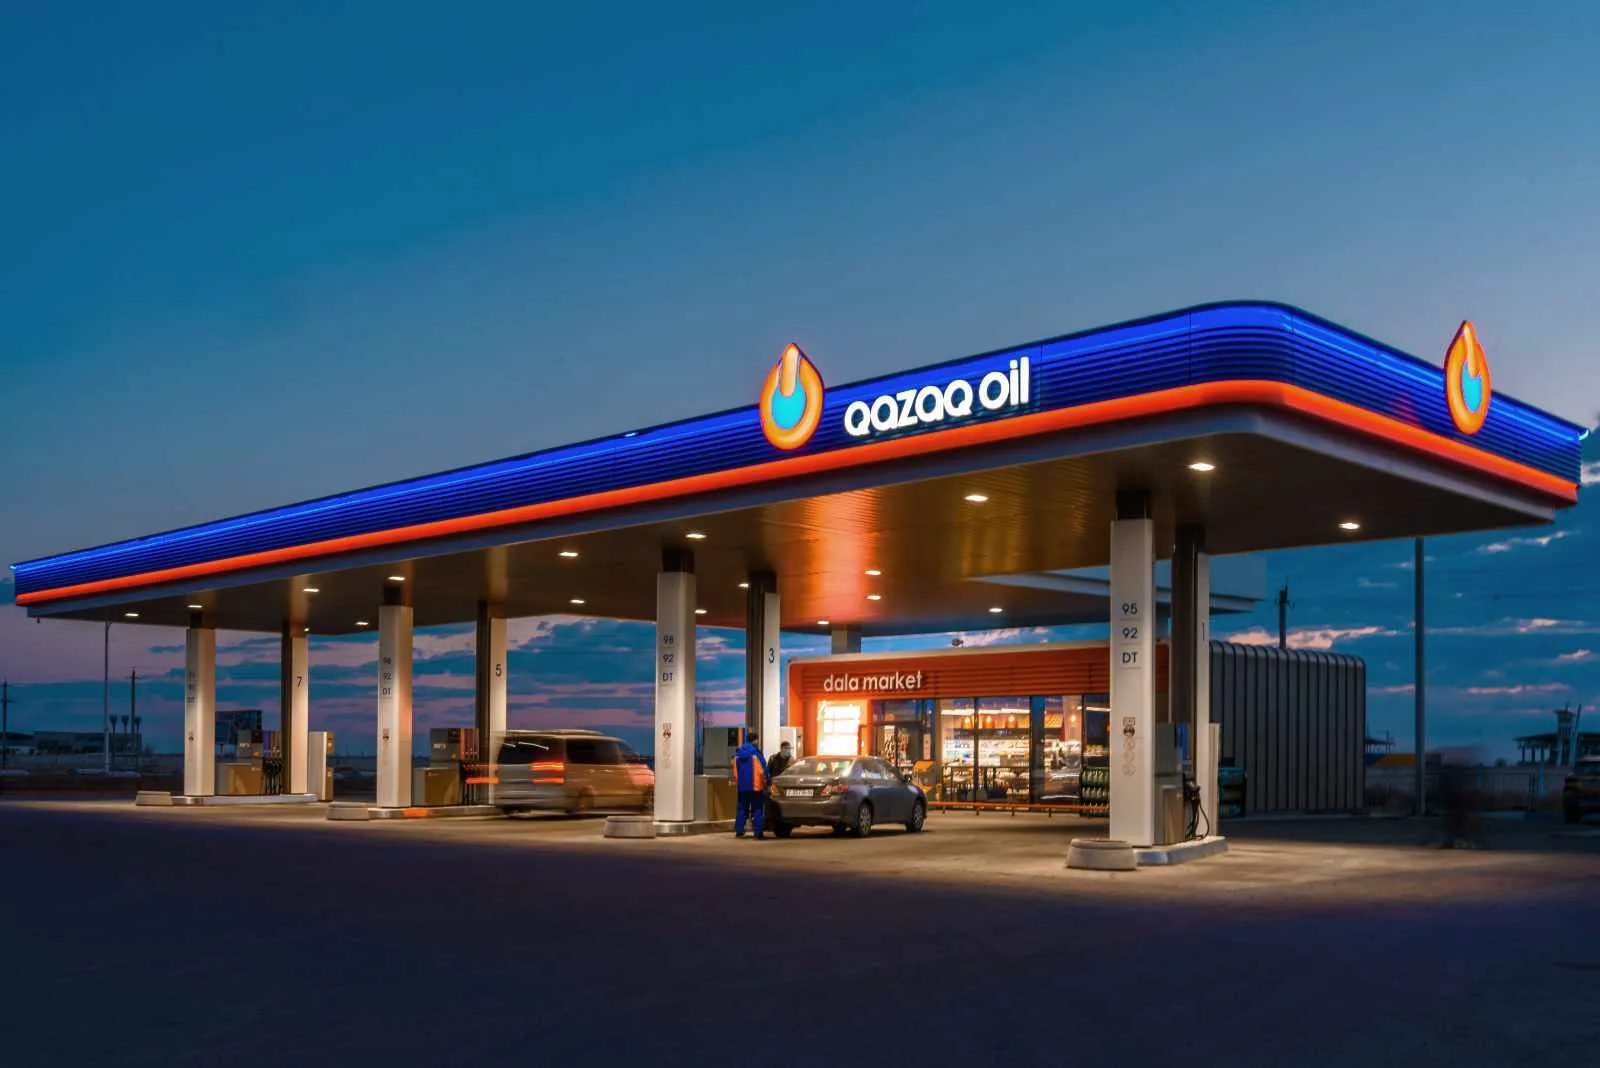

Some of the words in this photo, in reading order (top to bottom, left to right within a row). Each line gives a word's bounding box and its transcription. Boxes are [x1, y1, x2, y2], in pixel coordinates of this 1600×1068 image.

[1121, 602, 1138, 615] 95
[1122, 627, 1138, 639] 92
[662, 653, 673, 663] 92
[768, 647, 775, 663] 3
[1122, 651, 1138, 664] DT
[495, 663, 502, 677] 5
[296, 675, 303, 688] 7
[662, 672, 673, 682] DT
[823, 673, 859, 692] dala
[862, 670, 923, 690] market
